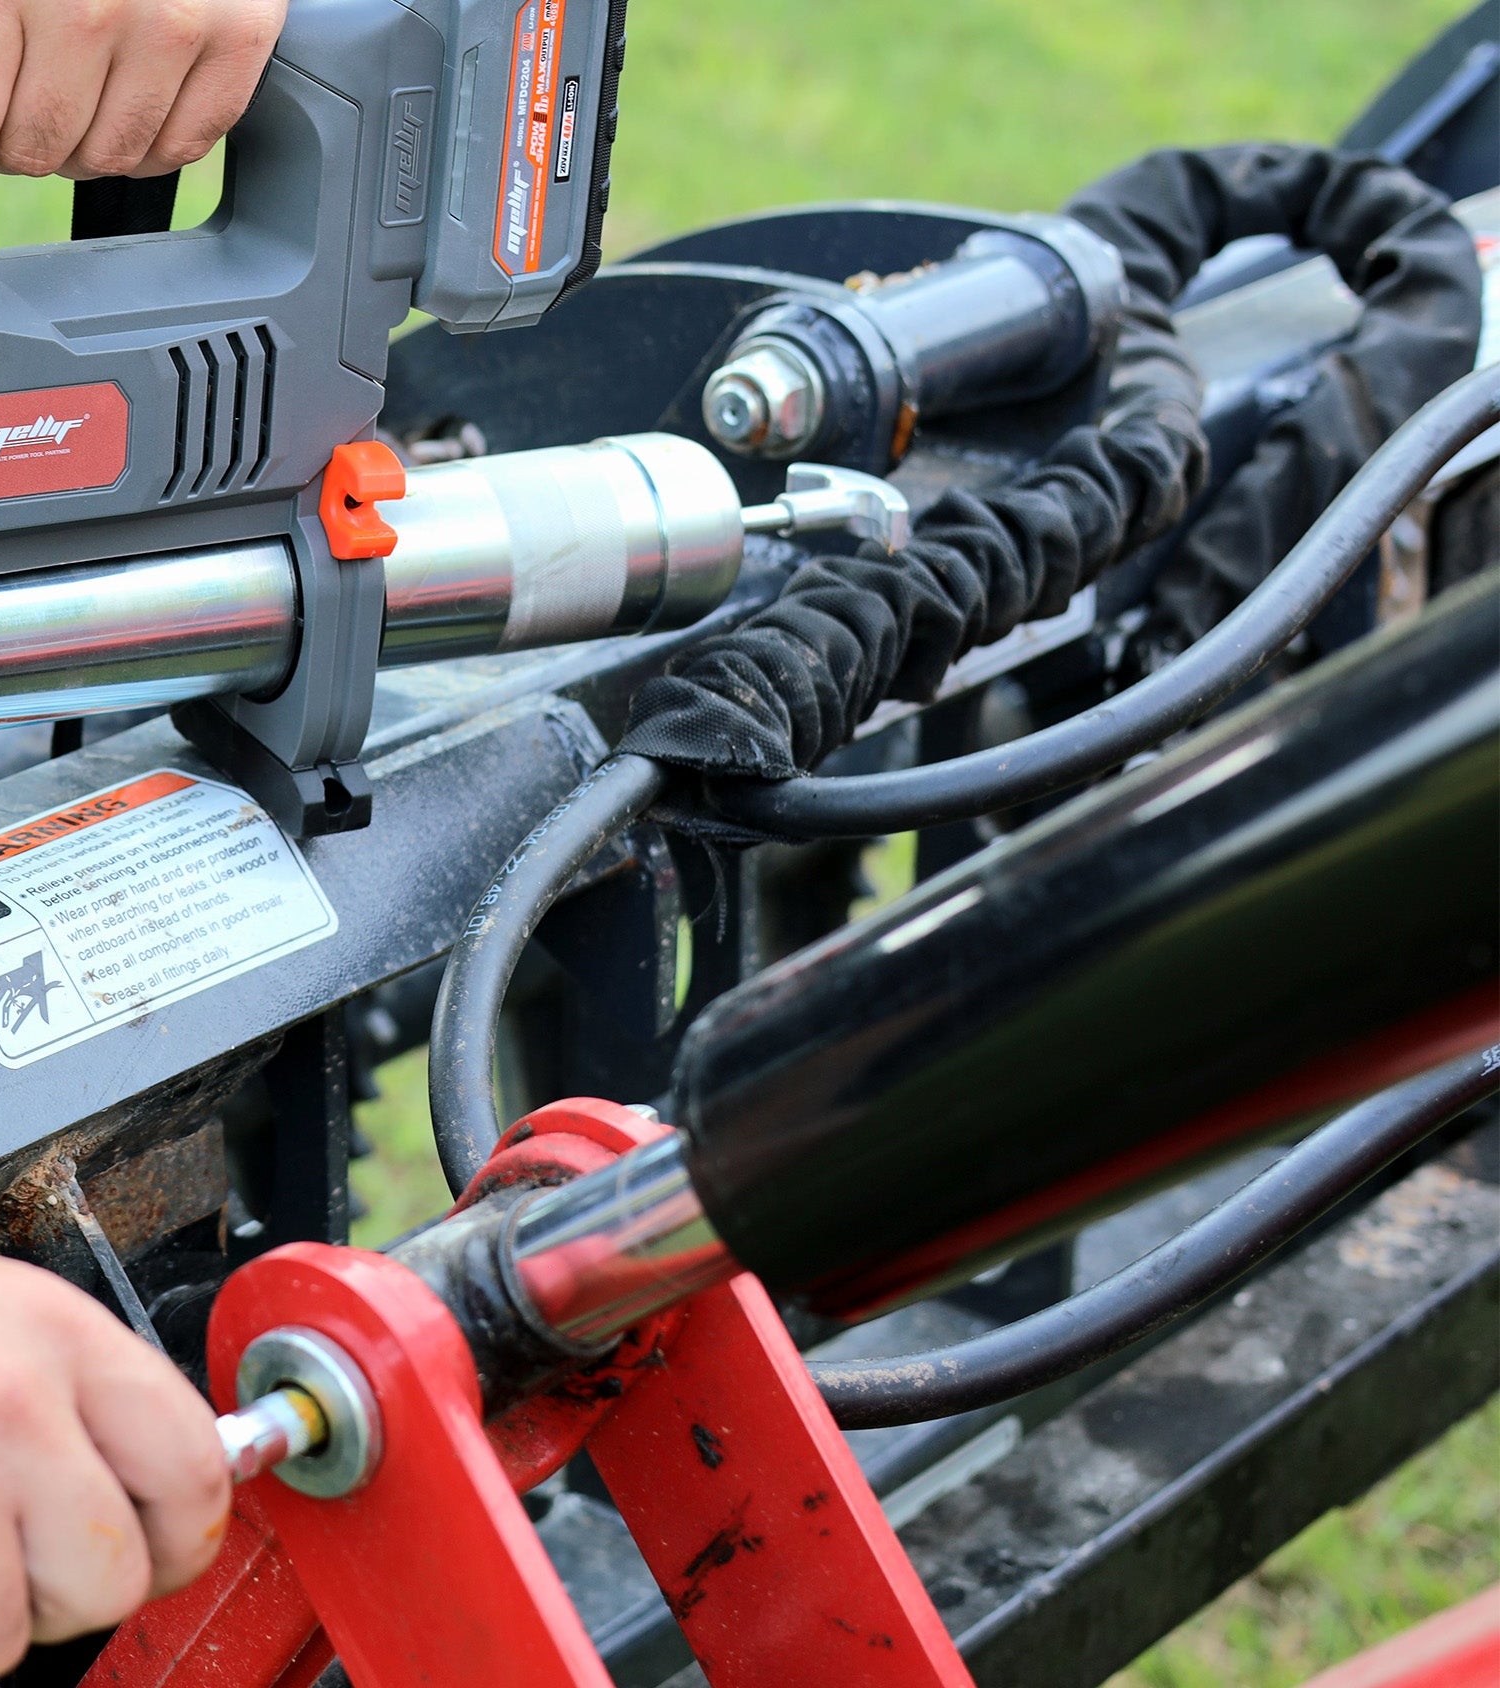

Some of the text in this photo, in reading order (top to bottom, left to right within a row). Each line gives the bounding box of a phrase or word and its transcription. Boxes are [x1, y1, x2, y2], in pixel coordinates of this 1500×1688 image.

[517, 59, 531, 116] MFDC204
[536, 31, 549, 95] MAX OUTPUT
[566, 85, 576, 111] LI-ION
[8, 453, 29, 462] POWER
[29, 451, 45, 459] TOOL
[45, 448, 71, 457] PARTNER
[103, 814, 146, 833] FLUID
[145, 790, 205, 816] HAZARD
[2, 873, 21, 885] To
[22, 858, 68, 879] prevent
[68, 839, 112, 859] serious
[112, 827, 146, 844] injury
[26, 808, 238, 897] Relieve pressure on hydraulic system
[42, 887, 82, 907] before
[82, 866, 137, 891] servicing
[136, 860, 149, 870] or
[150, 828, 229, 864] disconnecting
[55, 836, 262, 924] Wear proper hand and eye protection
[67, 923, 100, 943] when
[102, 899, 159, 929] searching
[158, 892, 175, 906] for
[210, 869, 235, 884] Use
[236, 854, 267, 874] wood
[267, 850, 280, 861] or
[77, 928, 137, 961] cardboard
[138, 911, 180, 937] instead
[181, 904, 193, 918] of
[87, 962, 121, 983] Keep
[122, 953, 137, 969] all
[138, 926, 208, 962] components
[208, 920, 220, 932] in
[221, 907, 251, 930] good
[102, 981, 147, 1006] Grease
[147, 971, 163, 989] all
[162, 957, 202, 982] fittings
